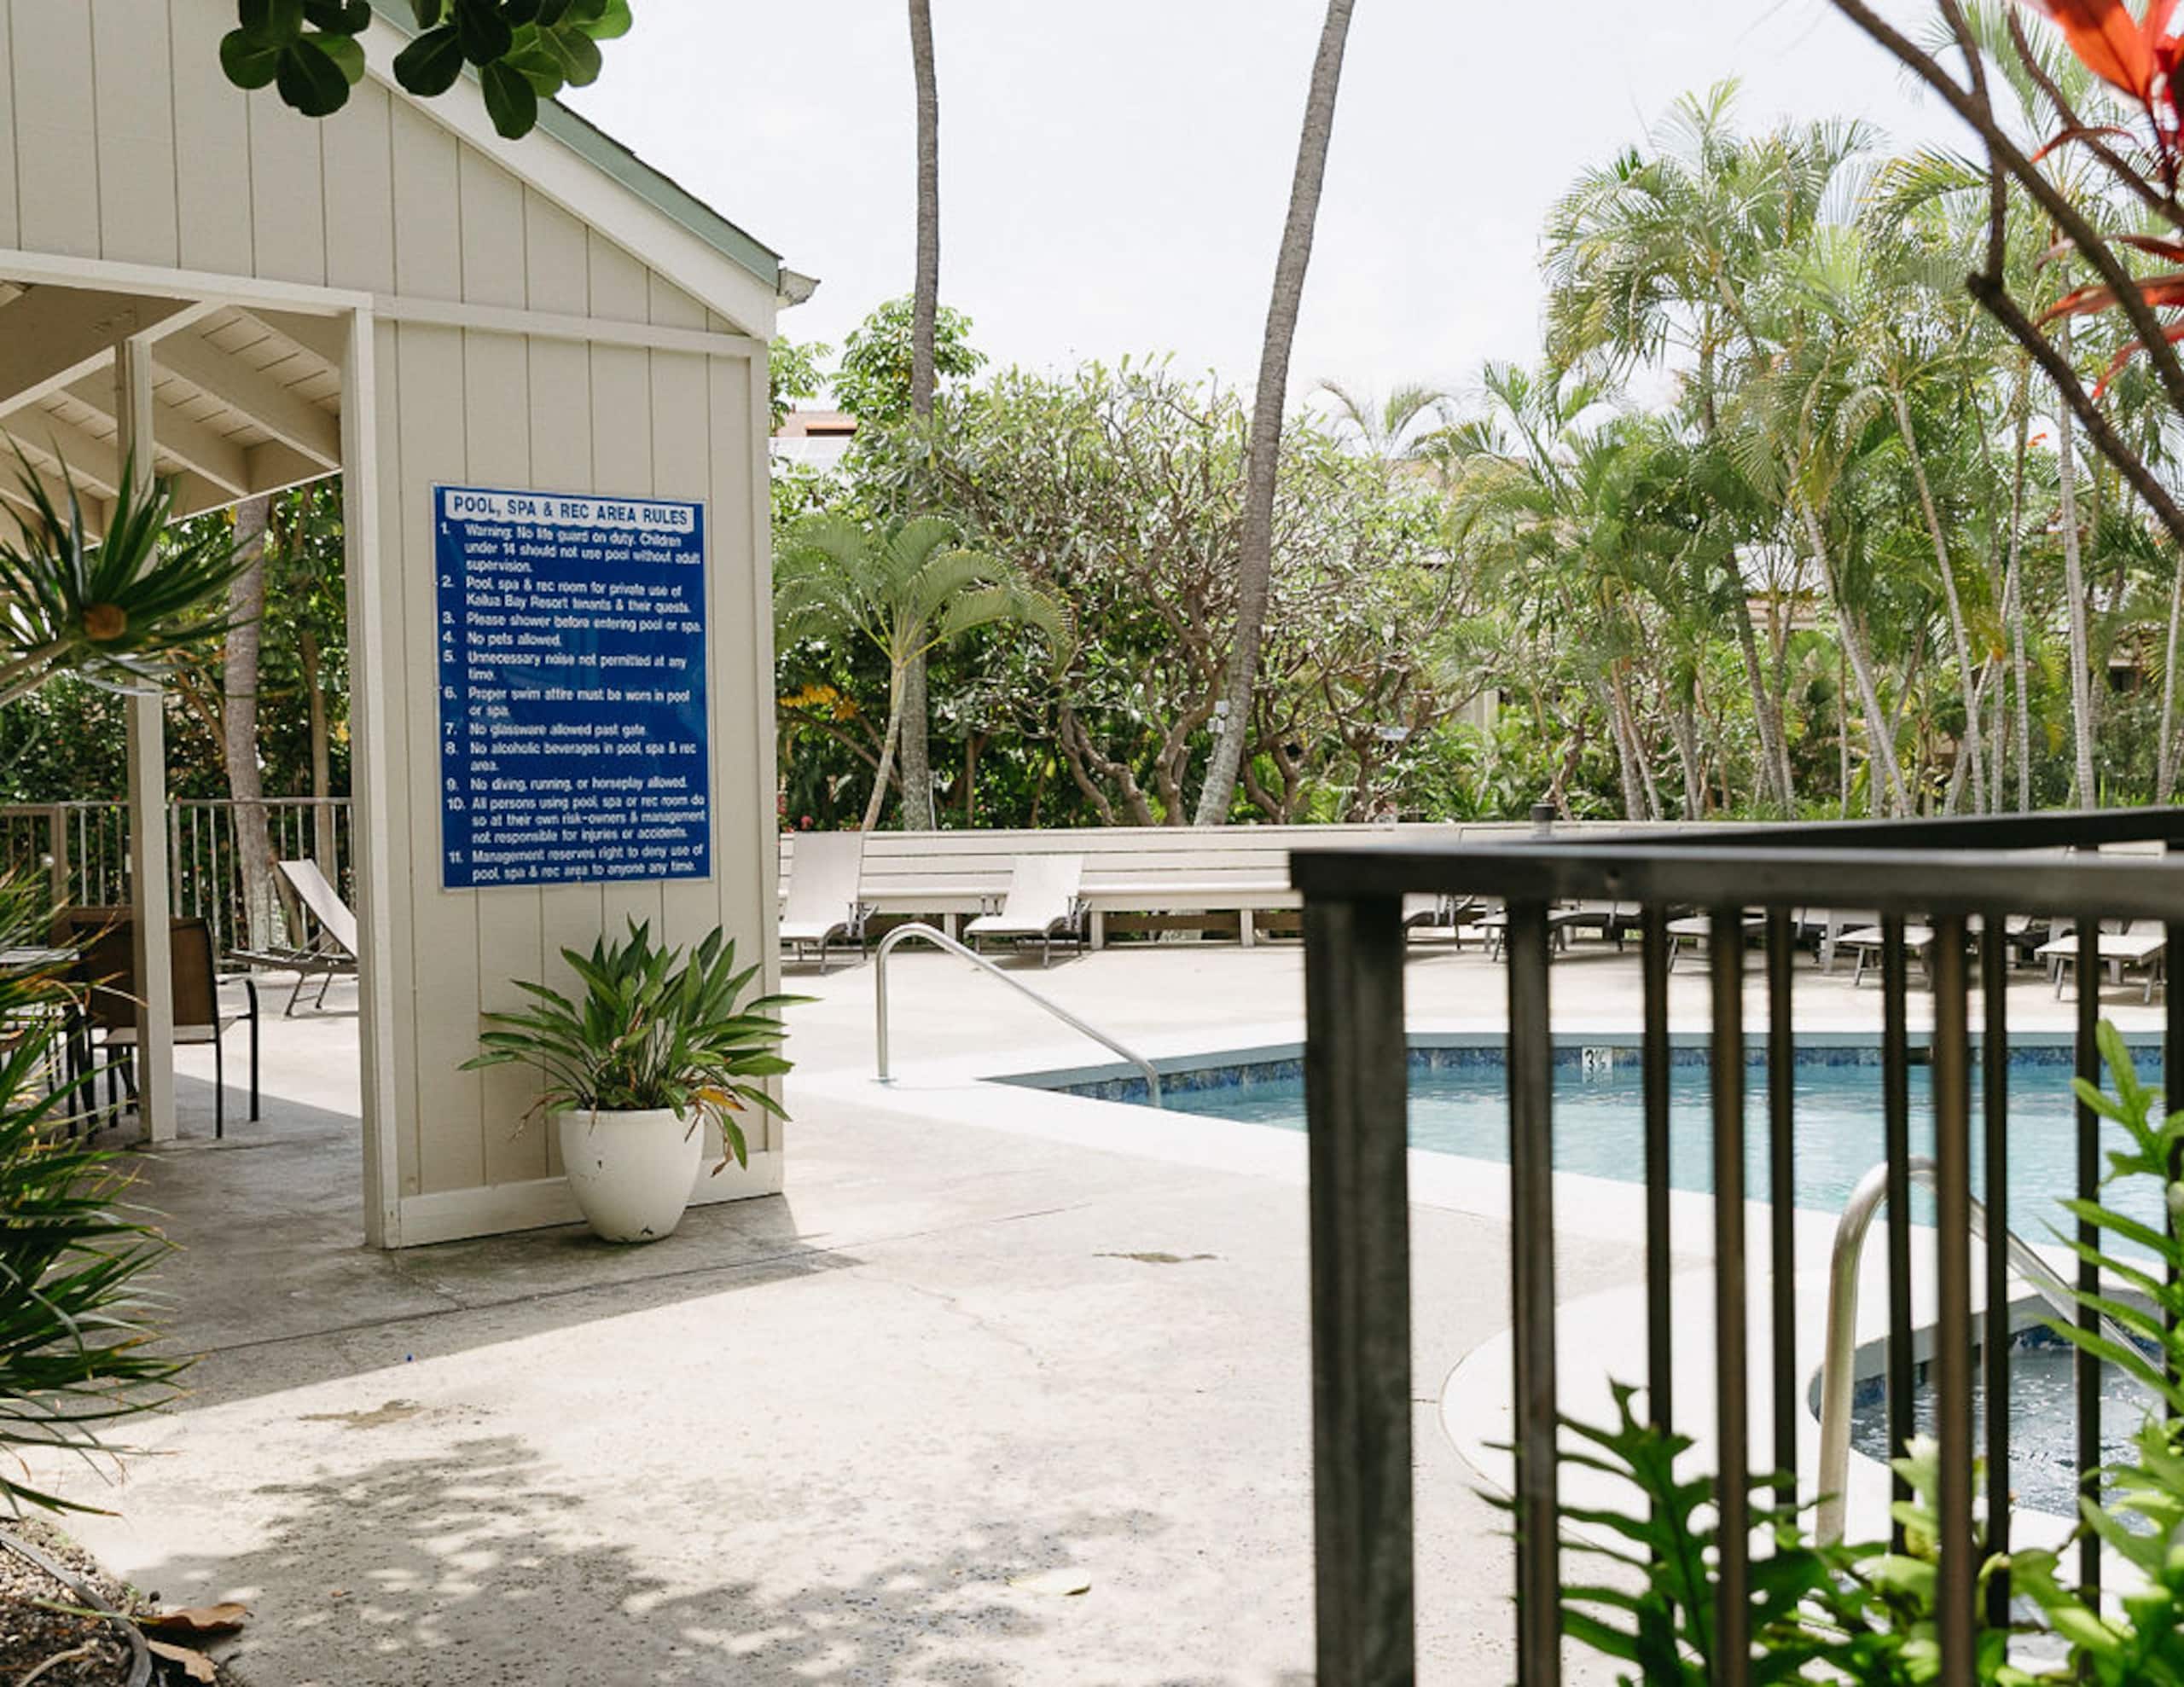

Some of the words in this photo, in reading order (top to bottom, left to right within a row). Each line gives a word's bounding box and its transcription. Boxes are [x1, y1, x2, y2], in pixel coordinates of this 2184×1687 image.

[453, 495, 501, 515] POOL,
[507, 498, 537, 515] SPA
[543, 501, 553, 517] &
[560, 501, 589, 519] REC
[595, 504, 636, 522] AREA
[642, 507, 687, 525] RULES
[516, 525, 534, 538] No
[556, 529, 590, 543] guard
[591, 531, 607, 543] on
[608, 531, 636, 547] duty.
[638, 531, 682, 548] Children
[466, 540, 497, 554] under
[502, 542, 515, 554] 14
[519, 542, 556, 557] should
[560, 545, 577, 558] not
[581, 548, 602, 559] use
[604, 548, 629, 562] pool
[632, 548, 671, 562] without
[675, 552, 700, 565] adult
[465, 558, 533, 575] supervision.
[442, 574, 453, 588] 2.
[497, 579, 520, 592] spa
[523, 577, 532, 591] &
[536, 581, 554, 592] rec
[557, 582, 587, 593] room
[590, 581, 606, 594] for
[608, 582, 645, 596] private
[648, 585, 668, 596] use
[671, 585, 682, 597] of
[465, 593, 501, 606] Kailua
[503, 594, 526, 610] Bay
[529, 594, 568, 609] Resort
[572, 597, 611, 610] tenants
[615, 598, 624, 611] &
[442, 611, 455, 623] 3.
[466, 611, 507, 626] Please
[509, 613, 551, 628] shower
[553, 614, 590, 629] before
[593, 617, 636, 632] entering
[638, 618, 662, 632] pool
[665, 621, 677, 630] or
[467, 631, 484, 644] No
[487, 632, 512, 646] pets
[442, 649, 454, 662] 5.
[467, 651, 541, 666] Unnecessary
[544, 652, 575, 664] noise
[578, 652, 596, 665] not
[599, 654, 652, 669] permitted
[653, 655, 665, 666] at
[668, 658, 687, 669] any
[468, 668, 494, 681] time.
[444, 686, 456, 699] 6.
[468, 686, 507, 701] Proper
[510, 687, 541, 700] swim
[544, 687, 573, 700] attire
[576, 688, 604, 700] must
[606, 688, 622, 700] be
[625, 691, 652, 700] worn
[653, 692, 665, 700] in
[666, 689, 690, 703] pool
[468, 705, 481, 715] or
[445, 722, 456, 734] 7.
[469, 722, 486, 734] No
[489, 723, 546, 737] glassware
[549, 723, 592, 734] allowed
[594, 723, 618, 736] past
[469, 741, 487, 754] No
[490, 742, 540, 754] alcoholic
[543, 743, 601, 756] beverages
[603, 744, 613, 753] in
[644, 743, 665, 755] spa
[668, 741, 677, 753] &
[678, 743, 696, 753] rec
[469, 760, 499, 770] area.
[470, 777, 487, 790] No
[576, 779, 588, 789] or
[591, 776, 643, 791] horseplay
[446, 797, 465, 810] 10.
[472, 797, 487, 809] All
[489, 798, 537, 810] persons
[538, 797, 569, 810] using
[601, 797, 622, 808] spa
[625, 797, 637, 807] or
[641, 797, 658, 806] rec
[660, 796, 688, 806] room
[689, 794, 705, 805] do
[472, 815, 486, 826] so
[490, 815, 502, 826] at
[535, 815, 560, 824] own
[630, 811, 637, 823] &
[641, 809, 705, 824] management
[472, 831, 491, 843] not
[493, 829, 558, 844] responsible
[561, 829, 577, 841] for
[581, 829, 618, 843] injuries
[621, 829, 633, 838] or
[449, 851, 462, 862] 11.
[472, 848, 544, 865] Management
[548, 849, 595, 861] reserves
[598, 845, 623, 860] right
[627, 846, 638, 857] to
[642, 845, 666, 858] deny
[671, 845, 689, 856] use
[692, 844, 703, 855] of
[503, 868, 526, 880] spa
[527, 865, 537, 877] &
[541, 867, 560, 877] rec
[563, 866, 588, 877] area
[591, 864, 604, 875] to
[606, 862, 645, 875] anyone
[648, 862, 667, 874] any
[670, 860, 694, 871] time.
